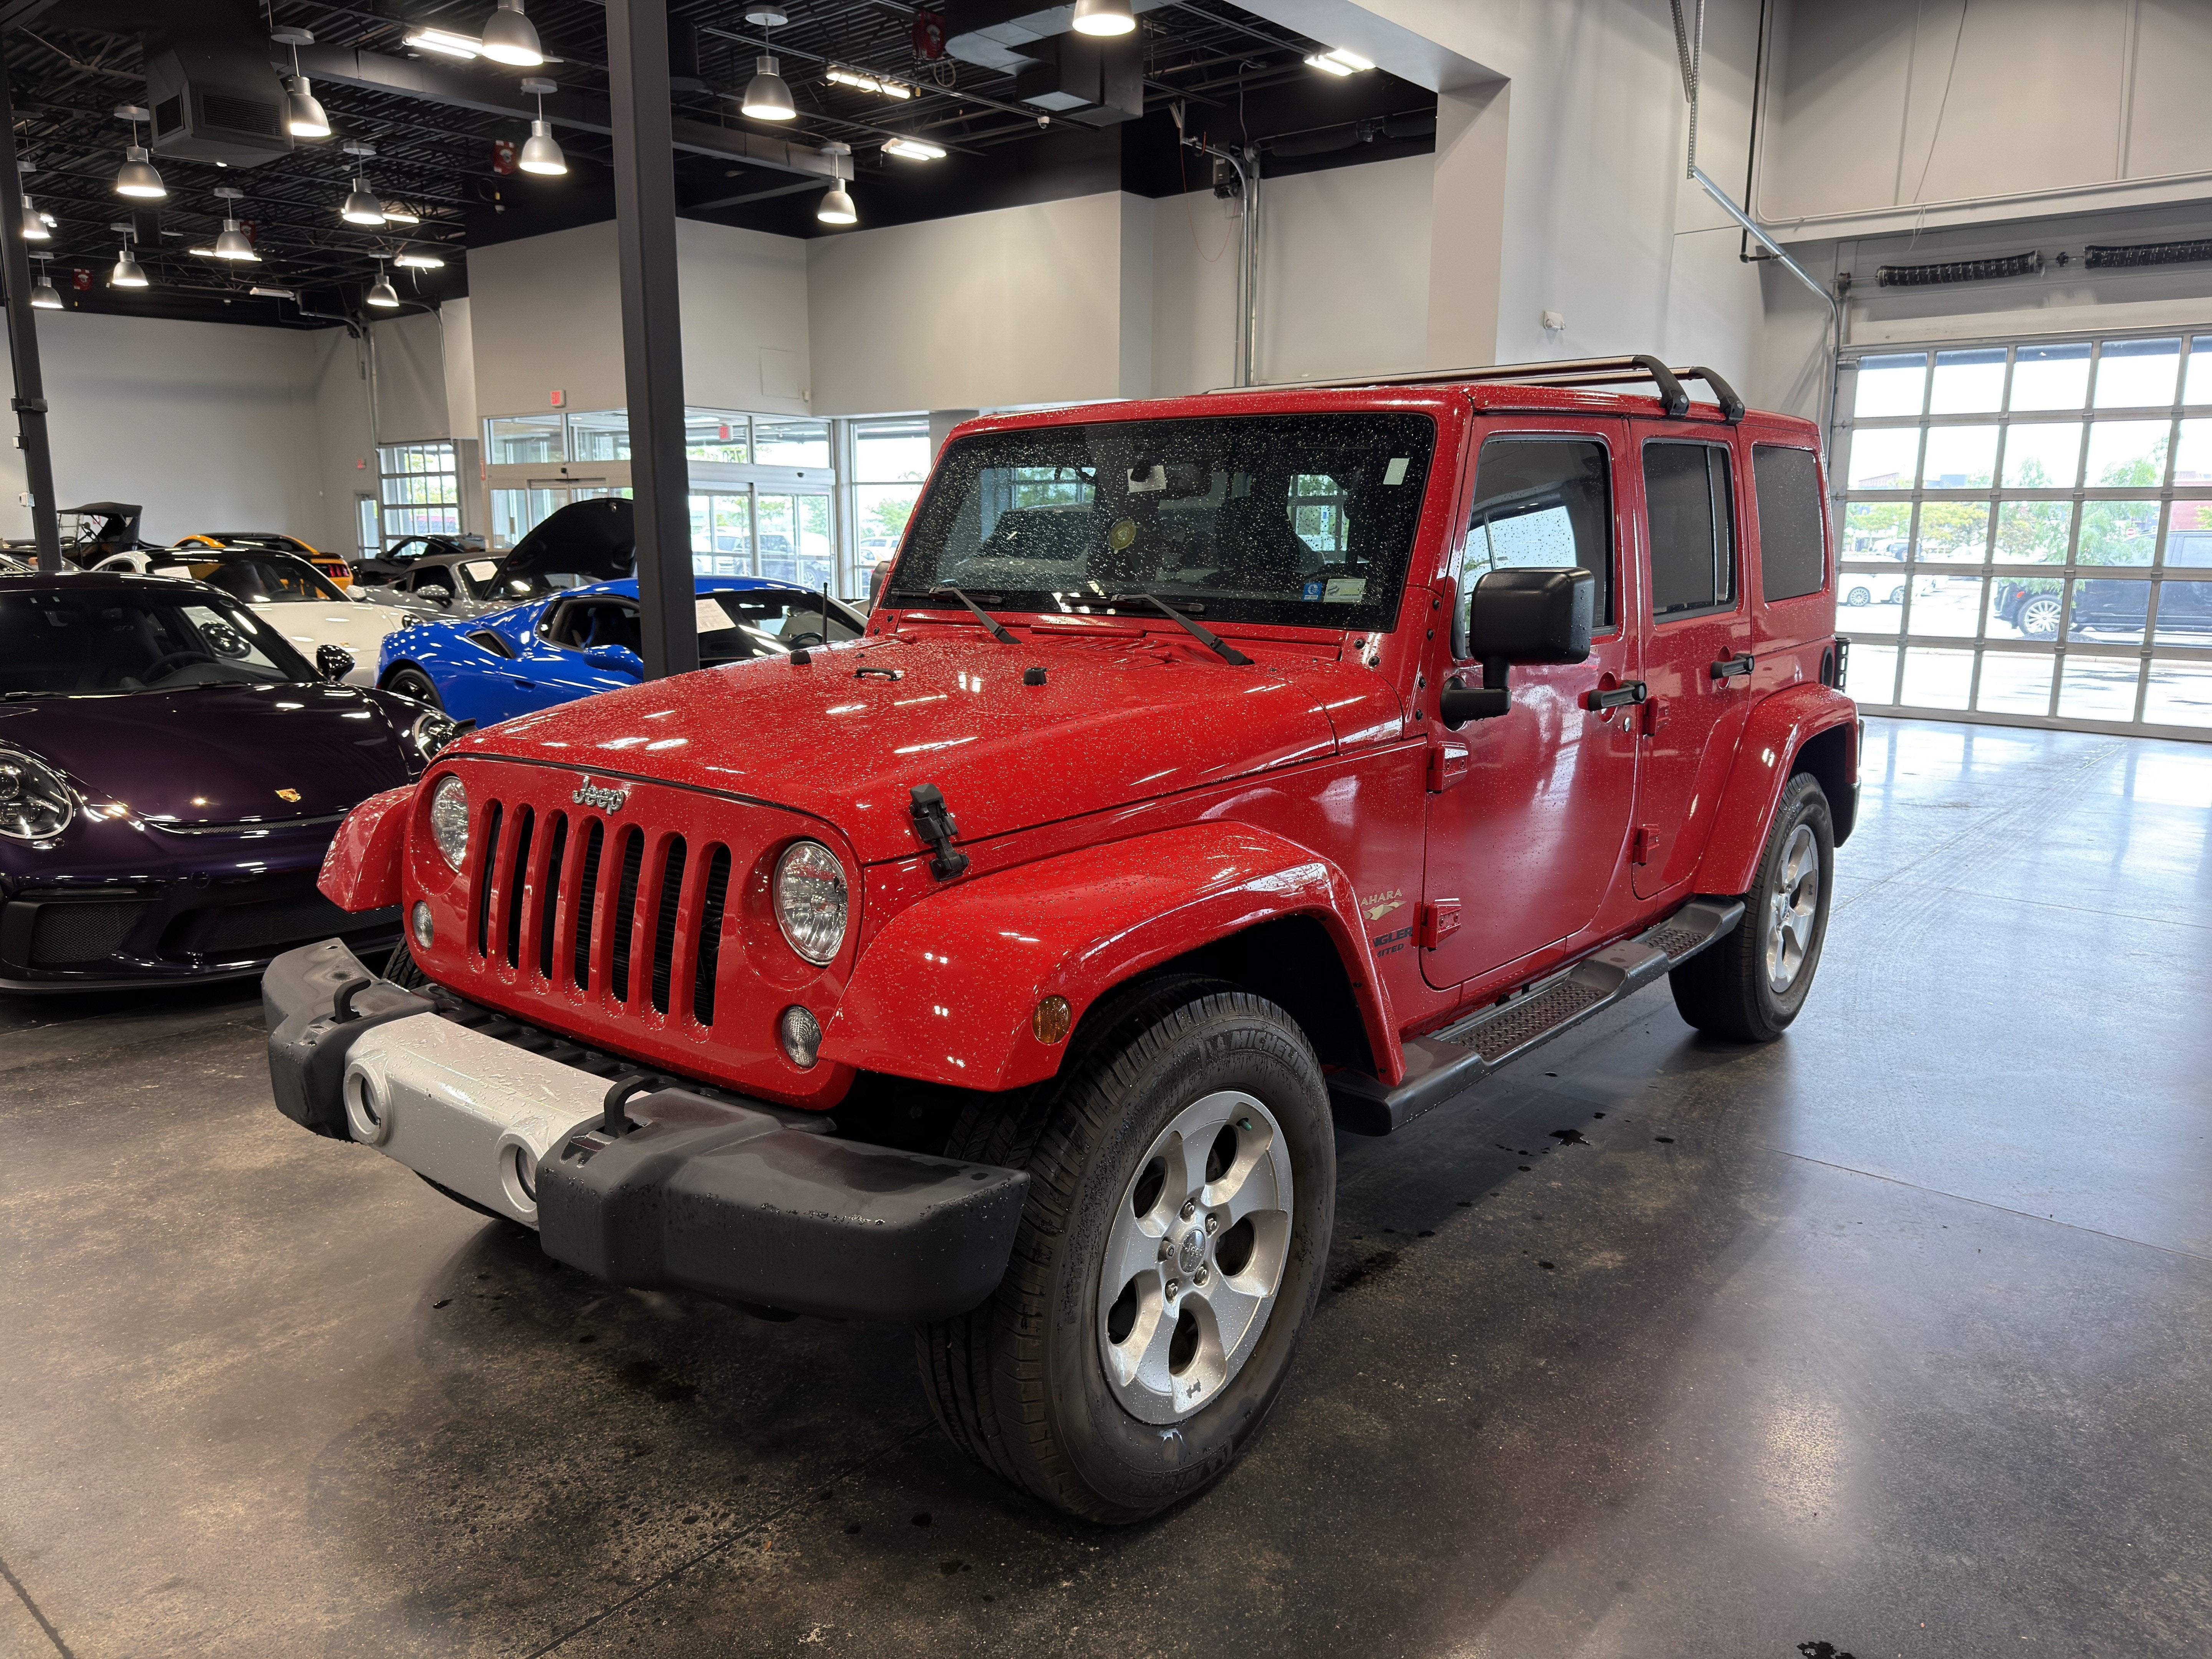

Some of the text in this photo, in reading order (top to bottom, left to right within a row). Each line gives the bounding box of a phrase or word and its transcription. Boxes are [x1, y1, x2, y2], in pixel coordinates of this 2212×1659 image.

[572, 775, 624, 816] Jeep
[1360, 888, 1402, 907] AHARA
[1373, 926, 1413, 947] NGLER
[1230, 1030, 1308, 1078] MICHELIN
